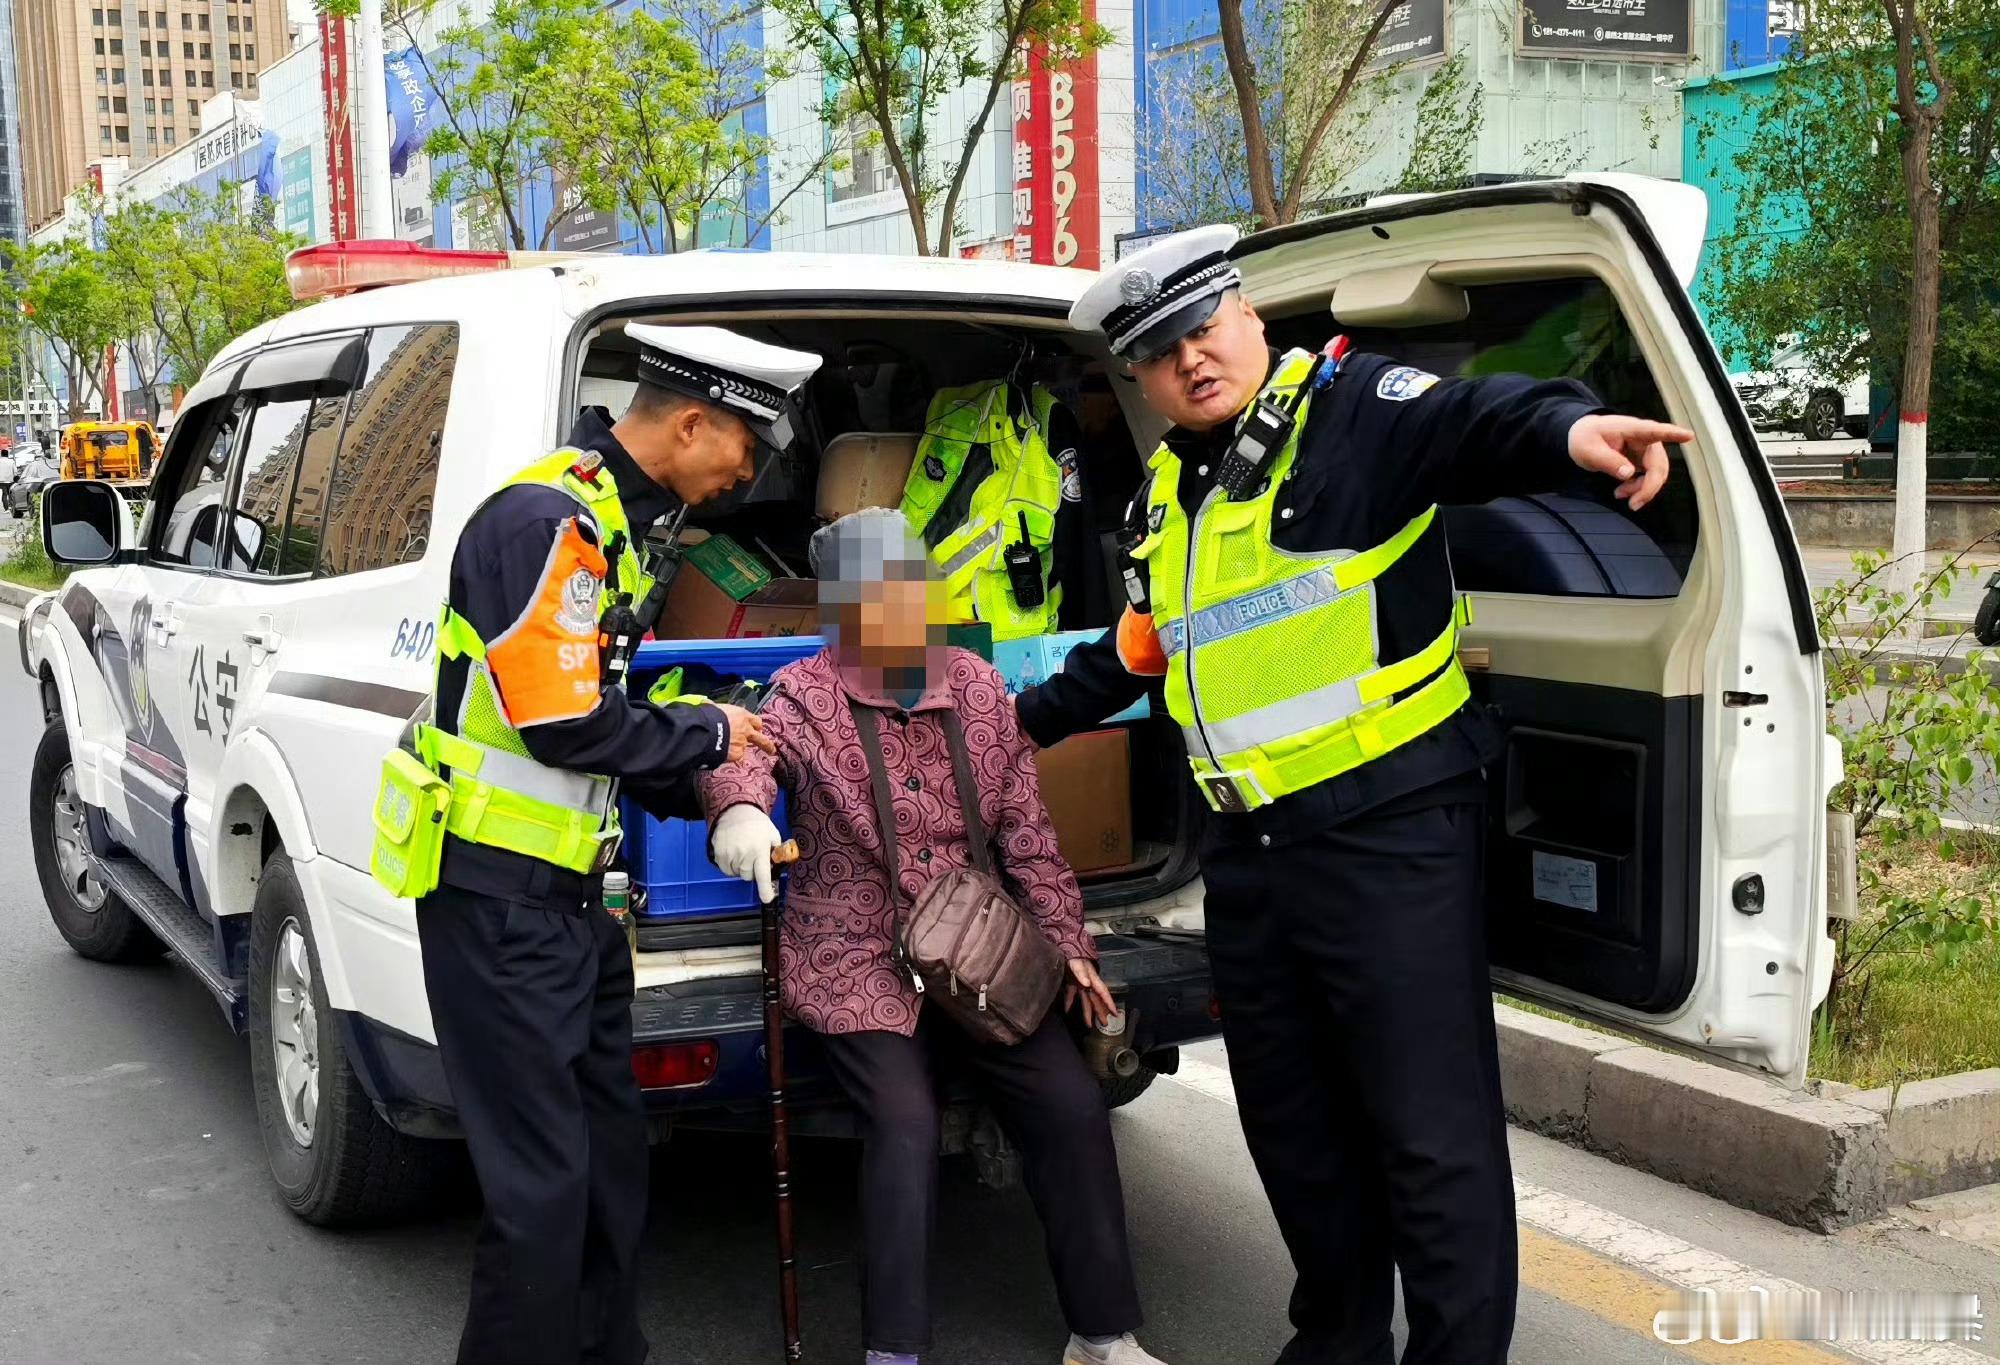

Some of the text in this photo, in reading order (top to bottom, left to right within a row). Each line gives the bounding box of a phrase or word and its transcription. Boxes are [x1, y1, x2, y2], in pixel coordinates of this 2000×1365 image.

[1239, 591, 1288, 620] POLICE
[391, 617, 435, 665] 640
[189, 644, 238, 747] 公安
